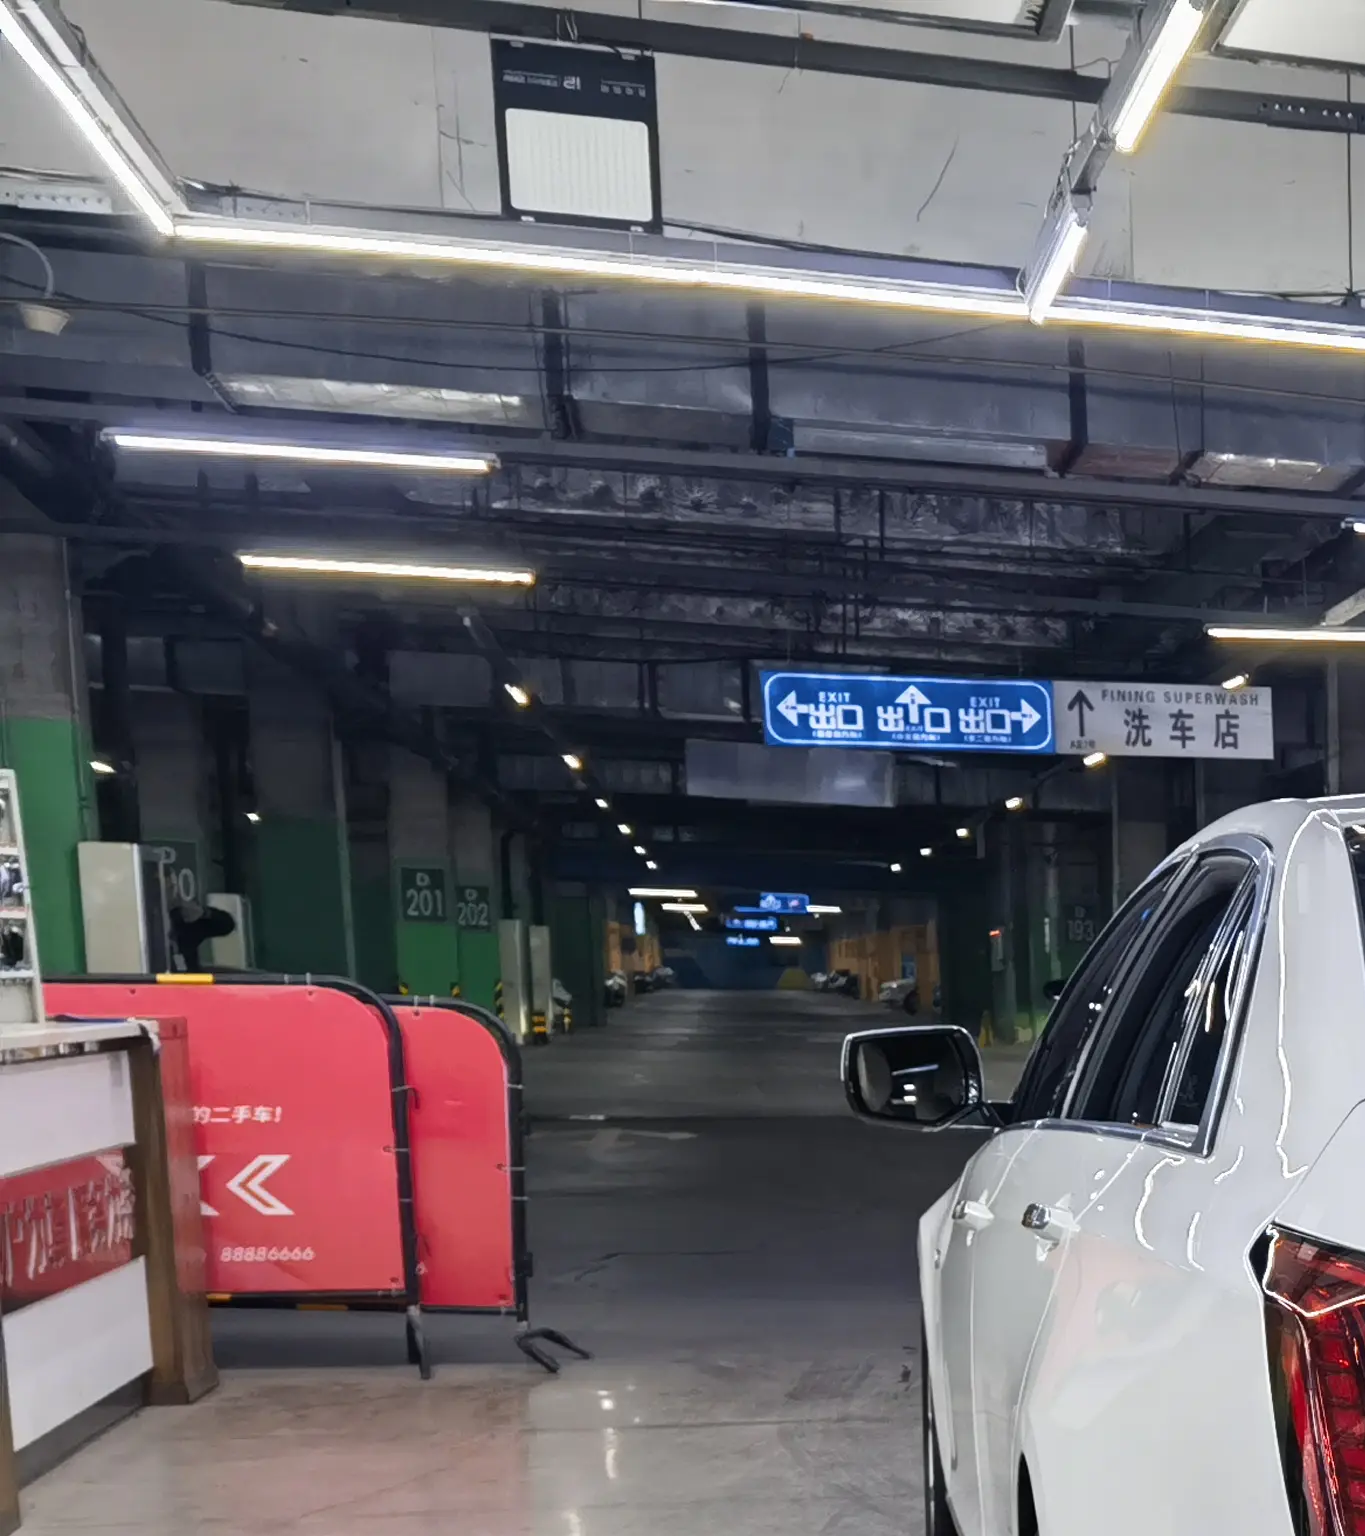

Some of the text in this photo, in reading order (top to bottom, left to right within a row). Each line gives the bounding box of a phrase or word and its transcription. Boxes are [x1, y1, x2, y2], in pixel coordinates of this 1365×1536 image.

[819, 692, 1000, 708] EXIT EXIT
[1101, 689, 1259, 706] FINING SUPERWASH
[809, 703, 1012, 734] 出口 出口 出口
[1124, 708, 1240, 750] 洗车店
[406, 888, 443, 917] 201
[457, 902, 488, 926] 202
[220, 1247, 316, 1262] 88886666
